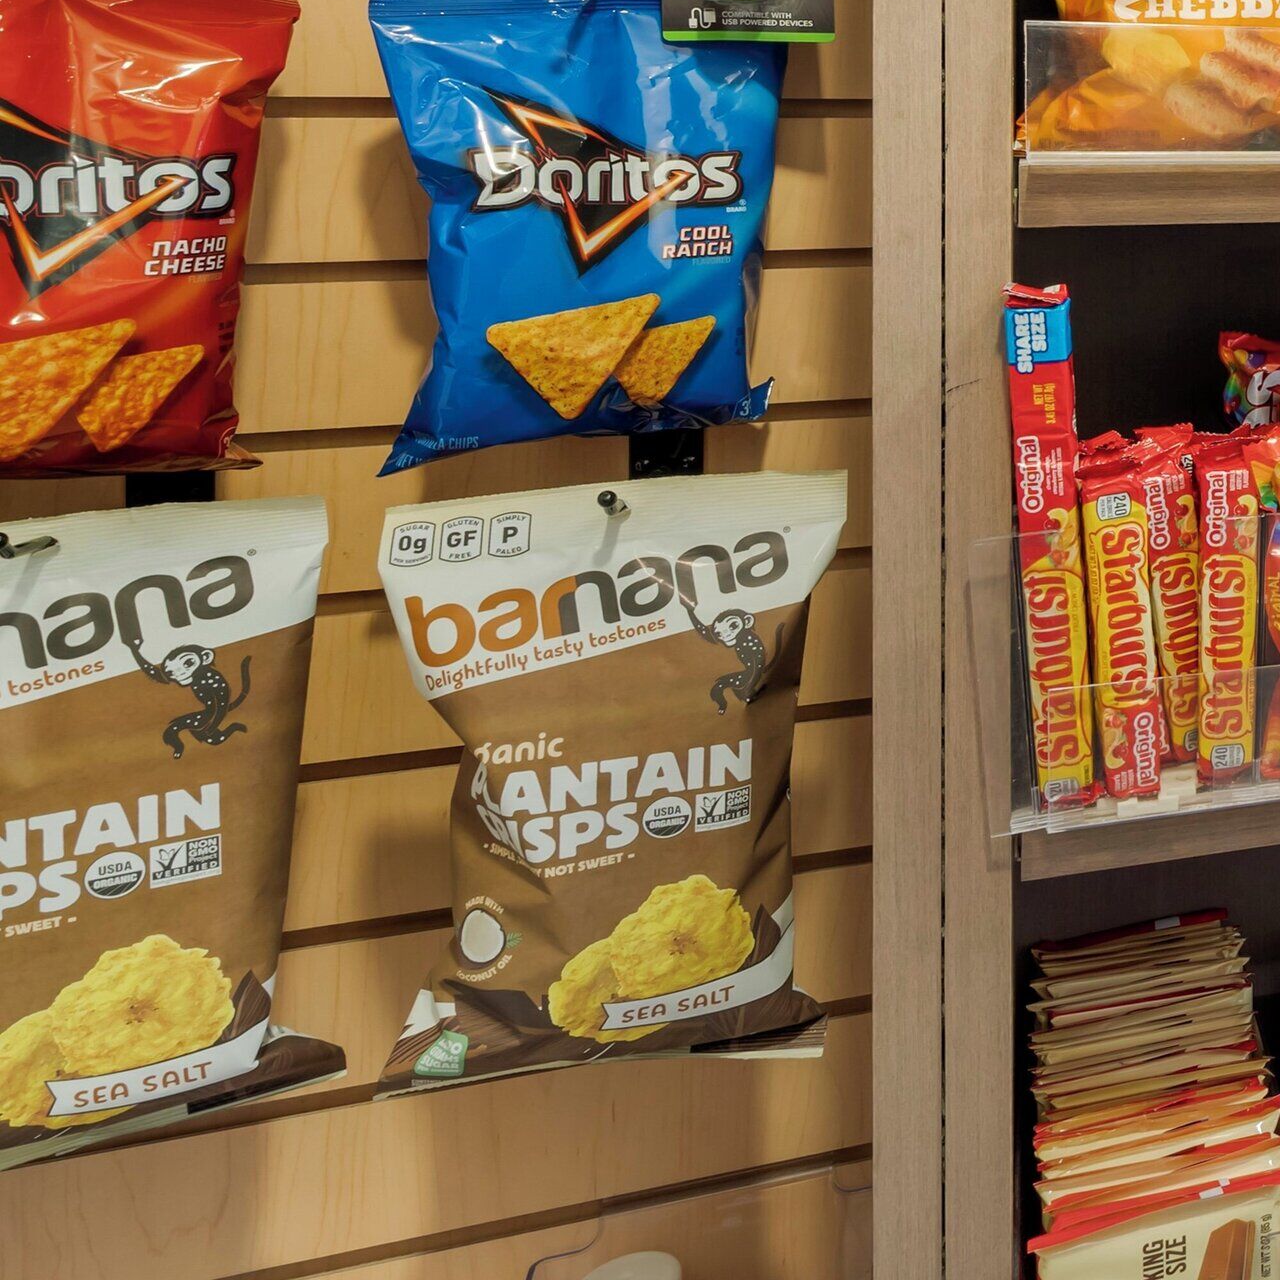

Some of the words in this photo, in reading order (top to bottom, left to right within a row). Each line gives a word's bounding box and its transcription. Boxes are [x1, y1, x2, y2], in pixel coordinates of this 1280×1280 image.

[721, 17, 741, 27] USB
[741, 18, 779, 28] POWERED
[780, 18, 814, 28] DEVICES
[473, 149, 743, 210] Doritos
[151, 235, 227, 257] NACHO
[678, 226, 731, 243] COOL
[661, 240, 733, 260] RANCH
[143, 254, 227, 277] CHEESE
[1015, 312, 1034, 374] SHARE
[1031, 310, 1048, 353] SIZE
[1022, 435, 1039, 515] Original
[1205, 473, 1228, 548] Original
[398, 533, 427, 556] 0g
[446, 529, 478, 550] GF
[502, 524, 519, 545] P
[404, 528, 790, 668] barnana
[1102, 525, 1154, 706] Starburst
[424, 655, 530, 693] Delightfully
[533, 637, 584, 664] tasty
[589, 618, 667, 649] tostones
[1202, 553, 1249, 738] Starburst
[9, 656, 105, 698] tostones
[1131, 711, 1153, 788] Original
[653, 804, 683, 819] USDA
[186, 836, 218, 851] NON
[187, 845, 218, 860] GMO
[98, 859, 133, 877] USDA
[152, 862, 221, 881] VERIFIED
[544, 860, 577, 879] NOT
[577, 852, 625, 874] SWEET
[92, 873, 139, 891] ORGANIC
[4, 915, 62, 937] SWEET
[620, 1001, 671, 1025] SEA
[677, 984, 734, 1017] SALT
[73, 1081, 131, 1109] SEA
[143, 1060, 213, 1094] SALT
[1165, 1234, 1187, 1274] SIZE
